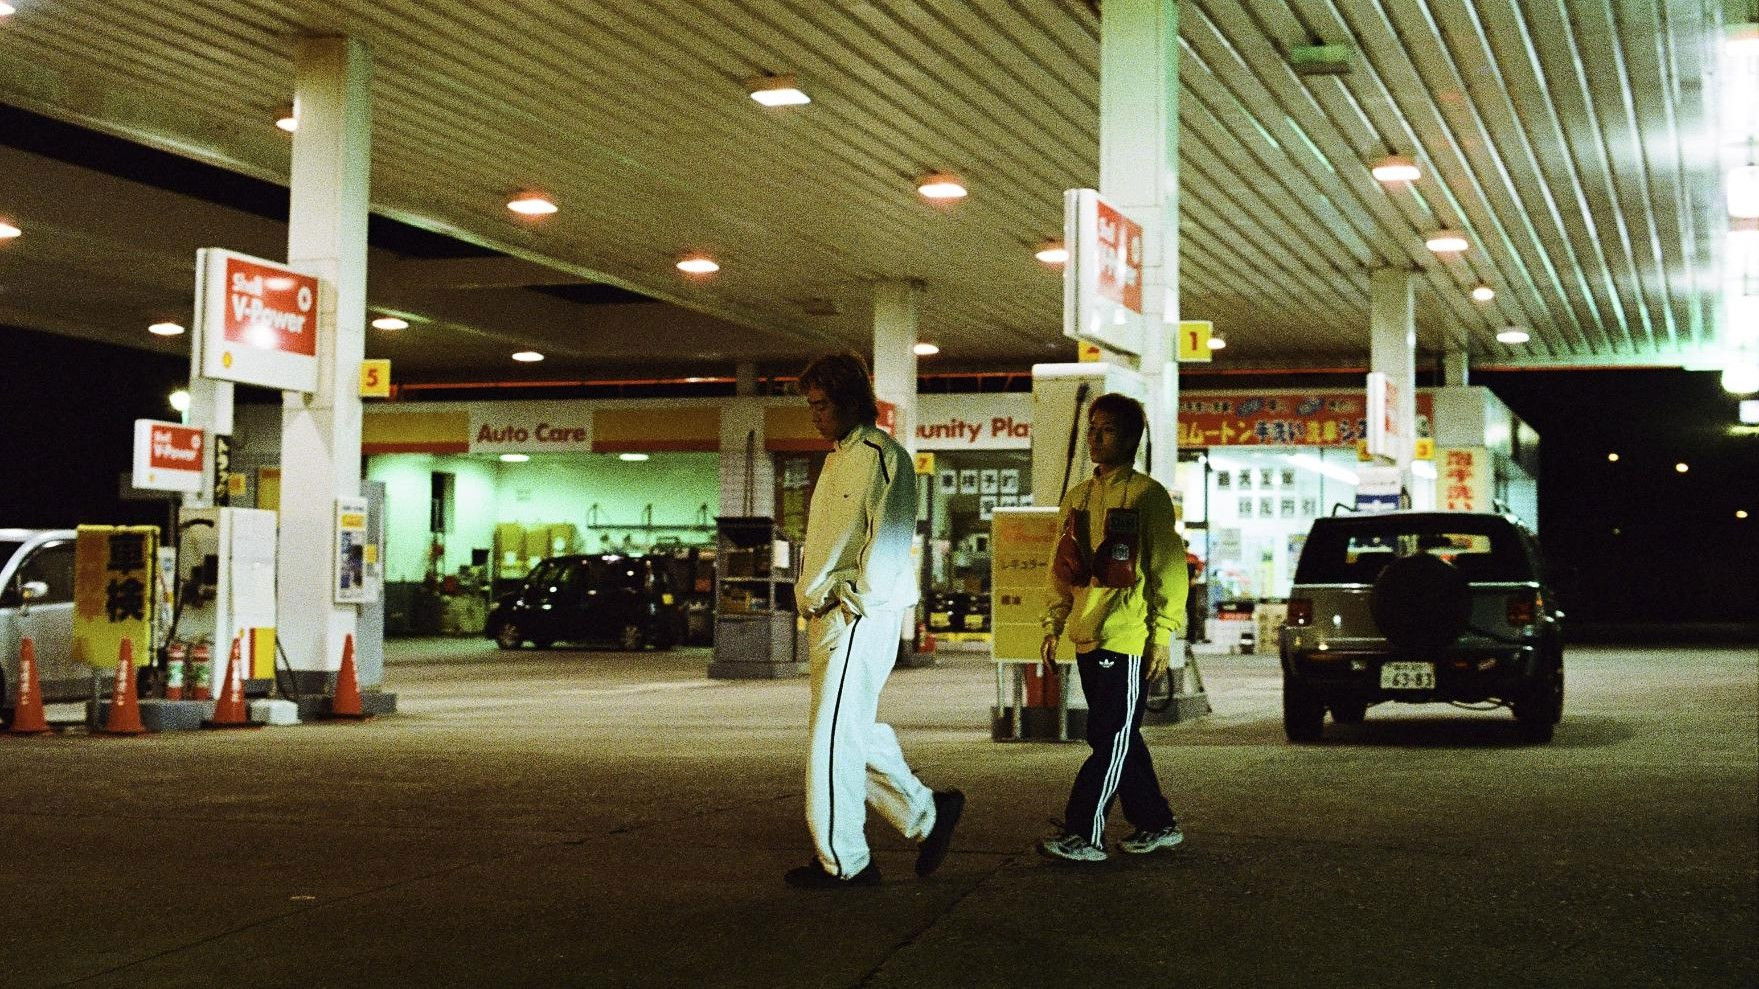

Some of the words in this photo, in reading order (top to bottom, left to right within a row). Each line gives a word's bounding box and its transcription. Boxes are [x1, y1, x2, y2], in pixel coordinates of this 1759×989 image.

[232, 294, 307, 334] V-Power
[1189, 331, 1198, 350] 1
[366, 368, 378, 388] 5
[477, 422, 528, 444] Auto
[535, 422, 587, 443] Care
[916, 418, 981, 443] unity
[918, 457, 928, 470] 7
